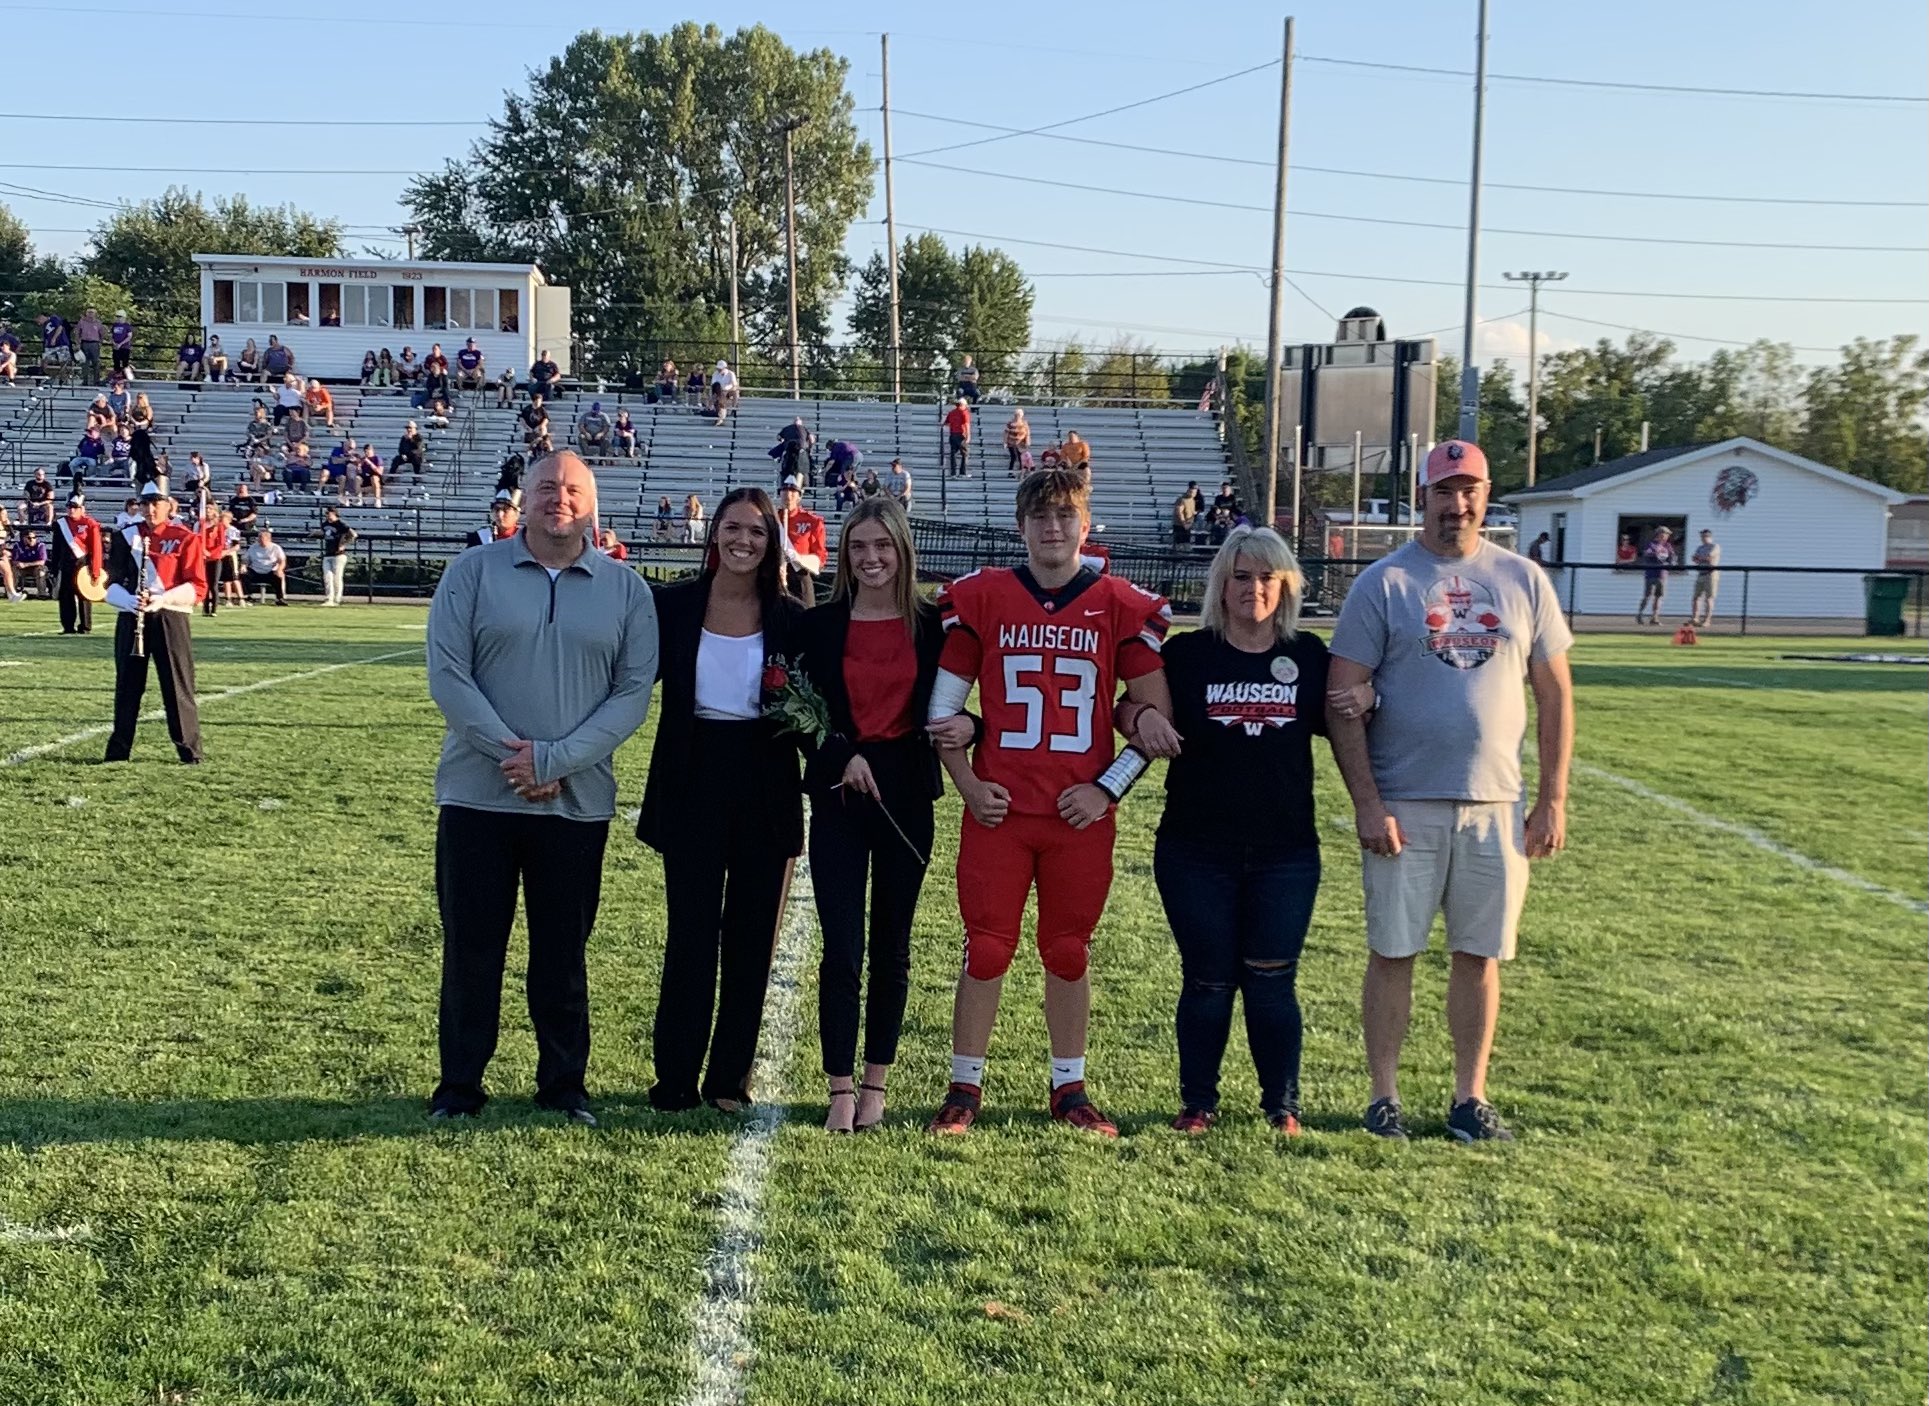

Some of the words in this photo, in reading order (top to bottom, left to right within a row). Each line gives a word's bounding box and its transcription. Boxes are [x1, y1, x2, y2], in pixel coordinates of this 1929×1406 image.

[300, 268, 345, 278] HARMON
[159, 539, 180, 555] W
[1452, 608, 1470, 619] W
[999, 624, 1099, 654] WAUSEON
[1205, 681, 1298, 705] WAUSEON
[1000, 655, 1098, 754] 53
[1243, 721, 1264, 736] W
